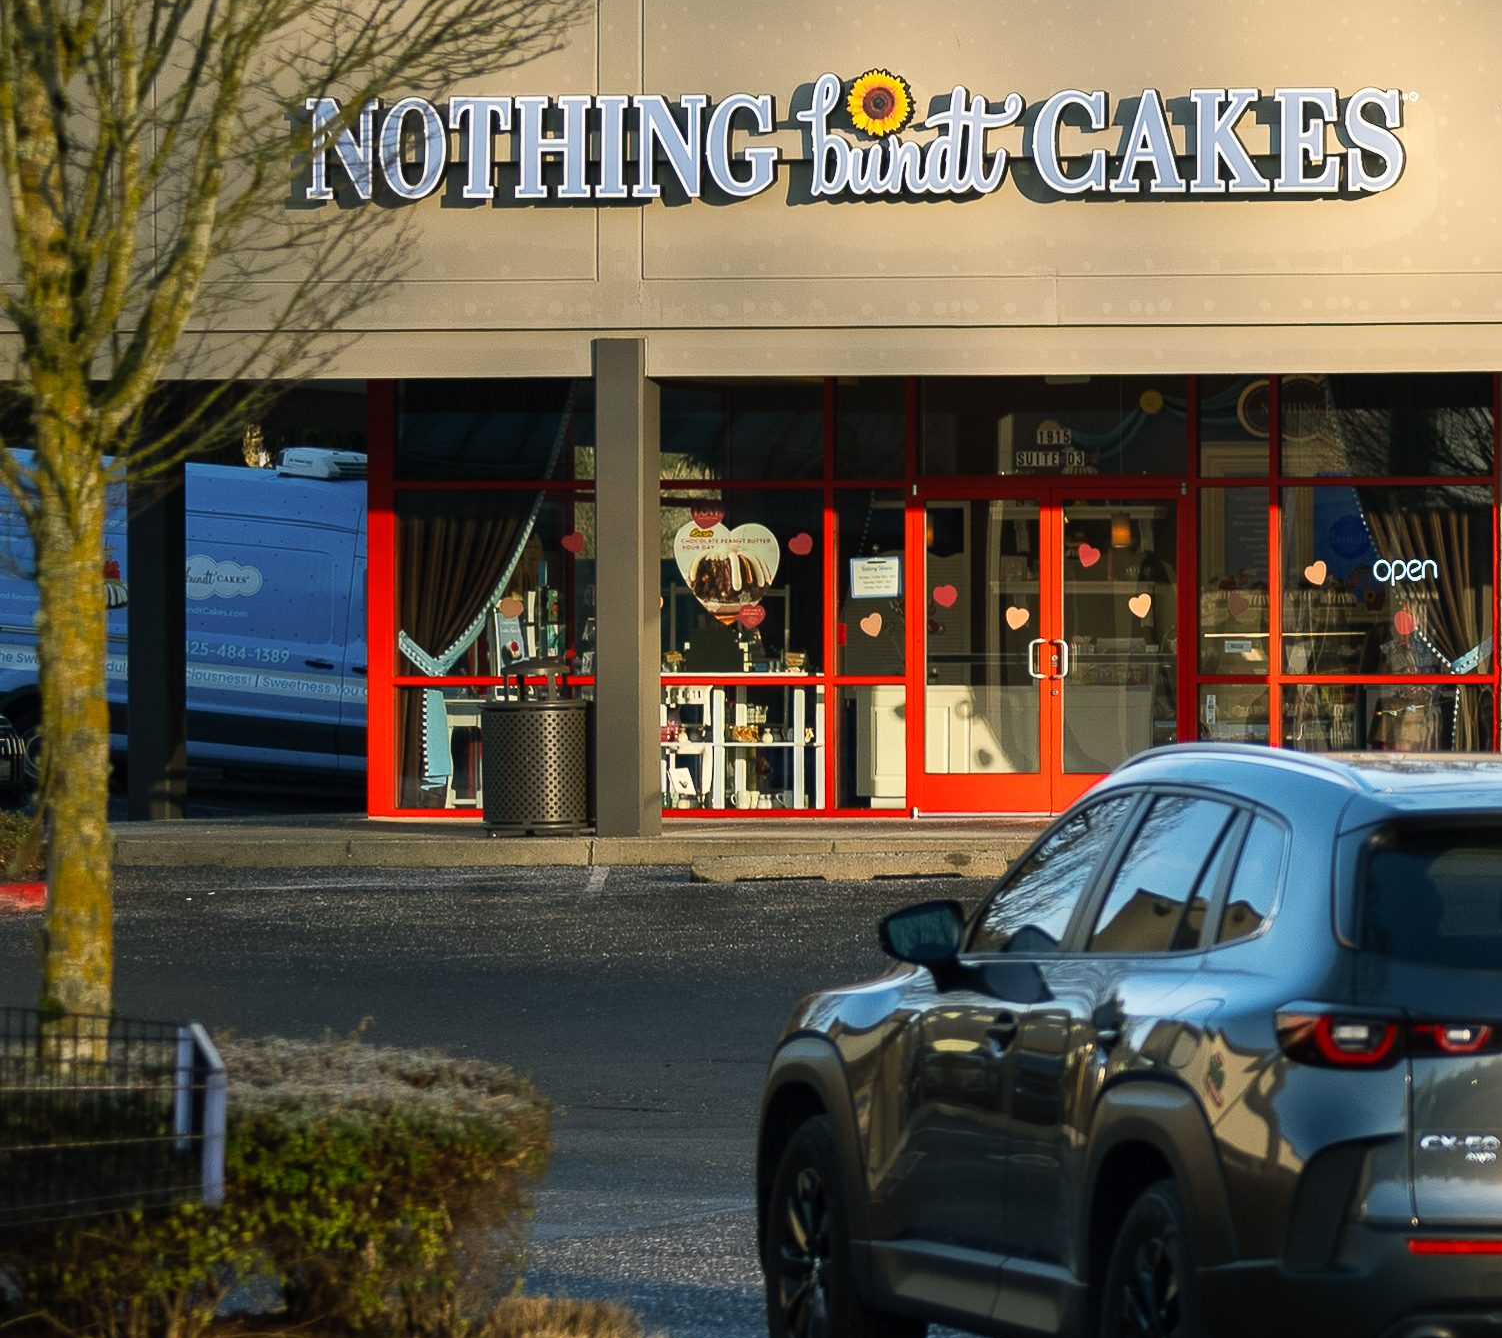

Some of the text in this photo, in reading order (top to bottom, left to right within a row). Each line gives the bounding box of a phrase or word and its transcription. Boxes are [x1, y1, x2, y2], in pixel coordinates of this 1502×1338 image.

[306, 73, 1403, 200] NOTHING bundt CAKES
[1260, 402, 1321, 416] NTHING
[1039, 429, 1071, 443] 1915
[1018, 452, 1085, 466] SUITE D3
[1373, 559, 1438, 586] open
[186, 641, 290, 663] 25-484-1389
[262, 676, 332, 694] Sweetness
